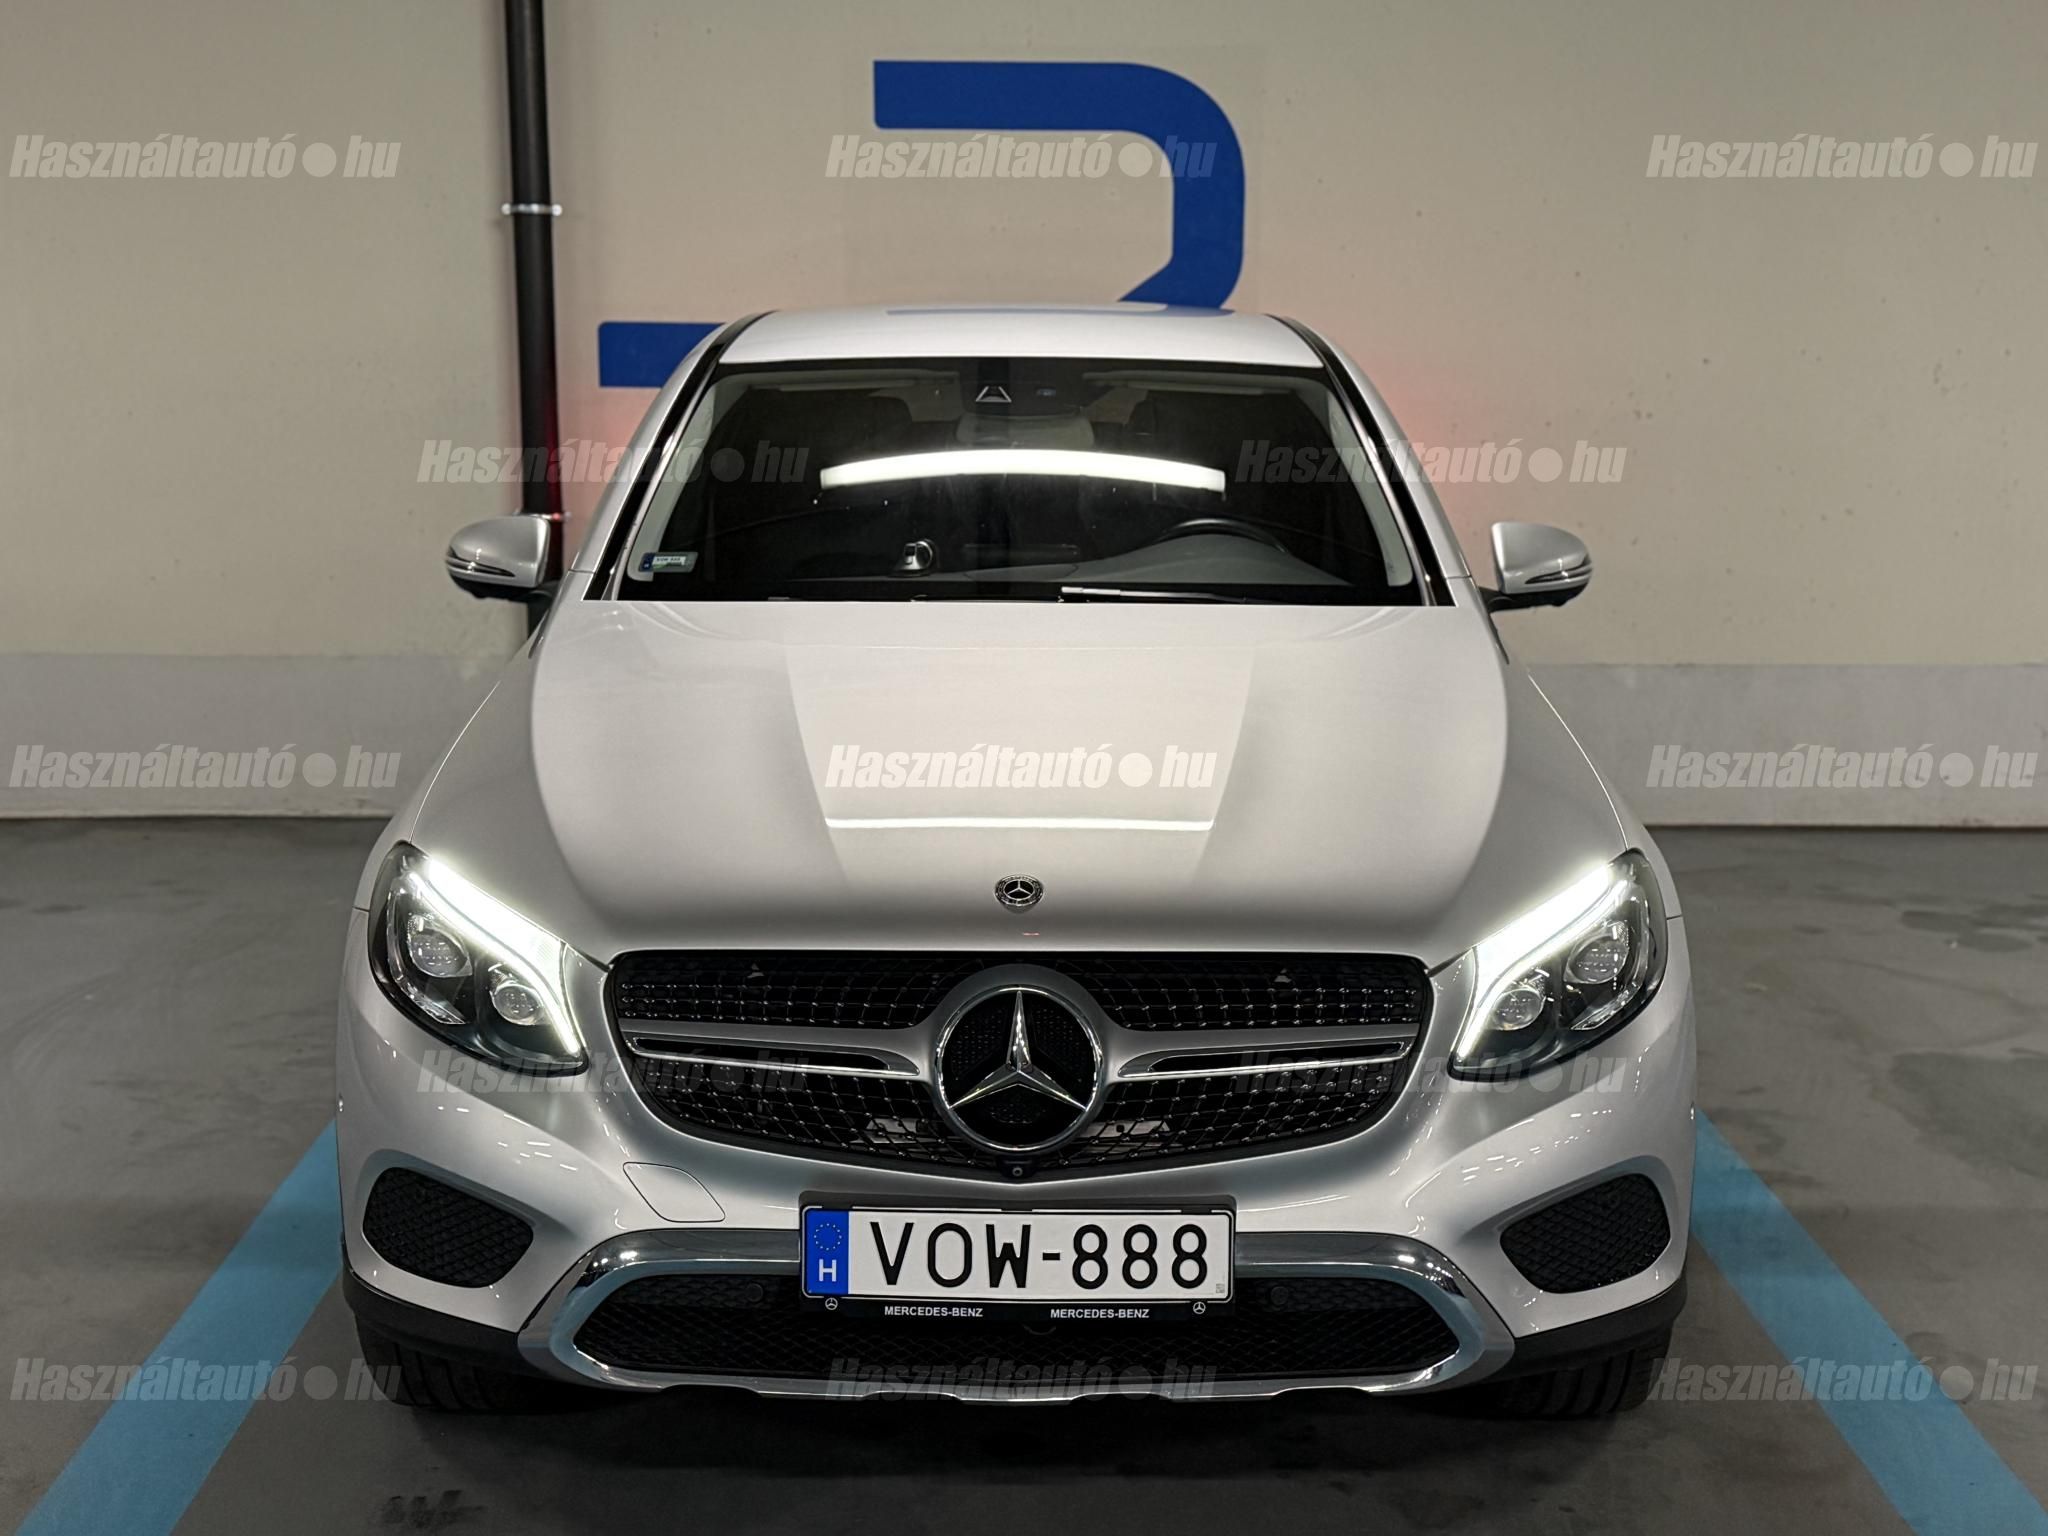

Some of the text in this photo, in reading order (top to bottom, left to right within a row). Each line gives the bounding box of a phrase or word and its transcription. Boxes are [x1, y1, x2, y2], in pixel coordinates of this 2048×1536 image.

[818, 1221, 1209, 1290] H VOW-888
[884, 1305, 984, 1318] MERCEDES-BENZ
[1050, 1307, 1150, 1320] MERCEDES-BENZ
